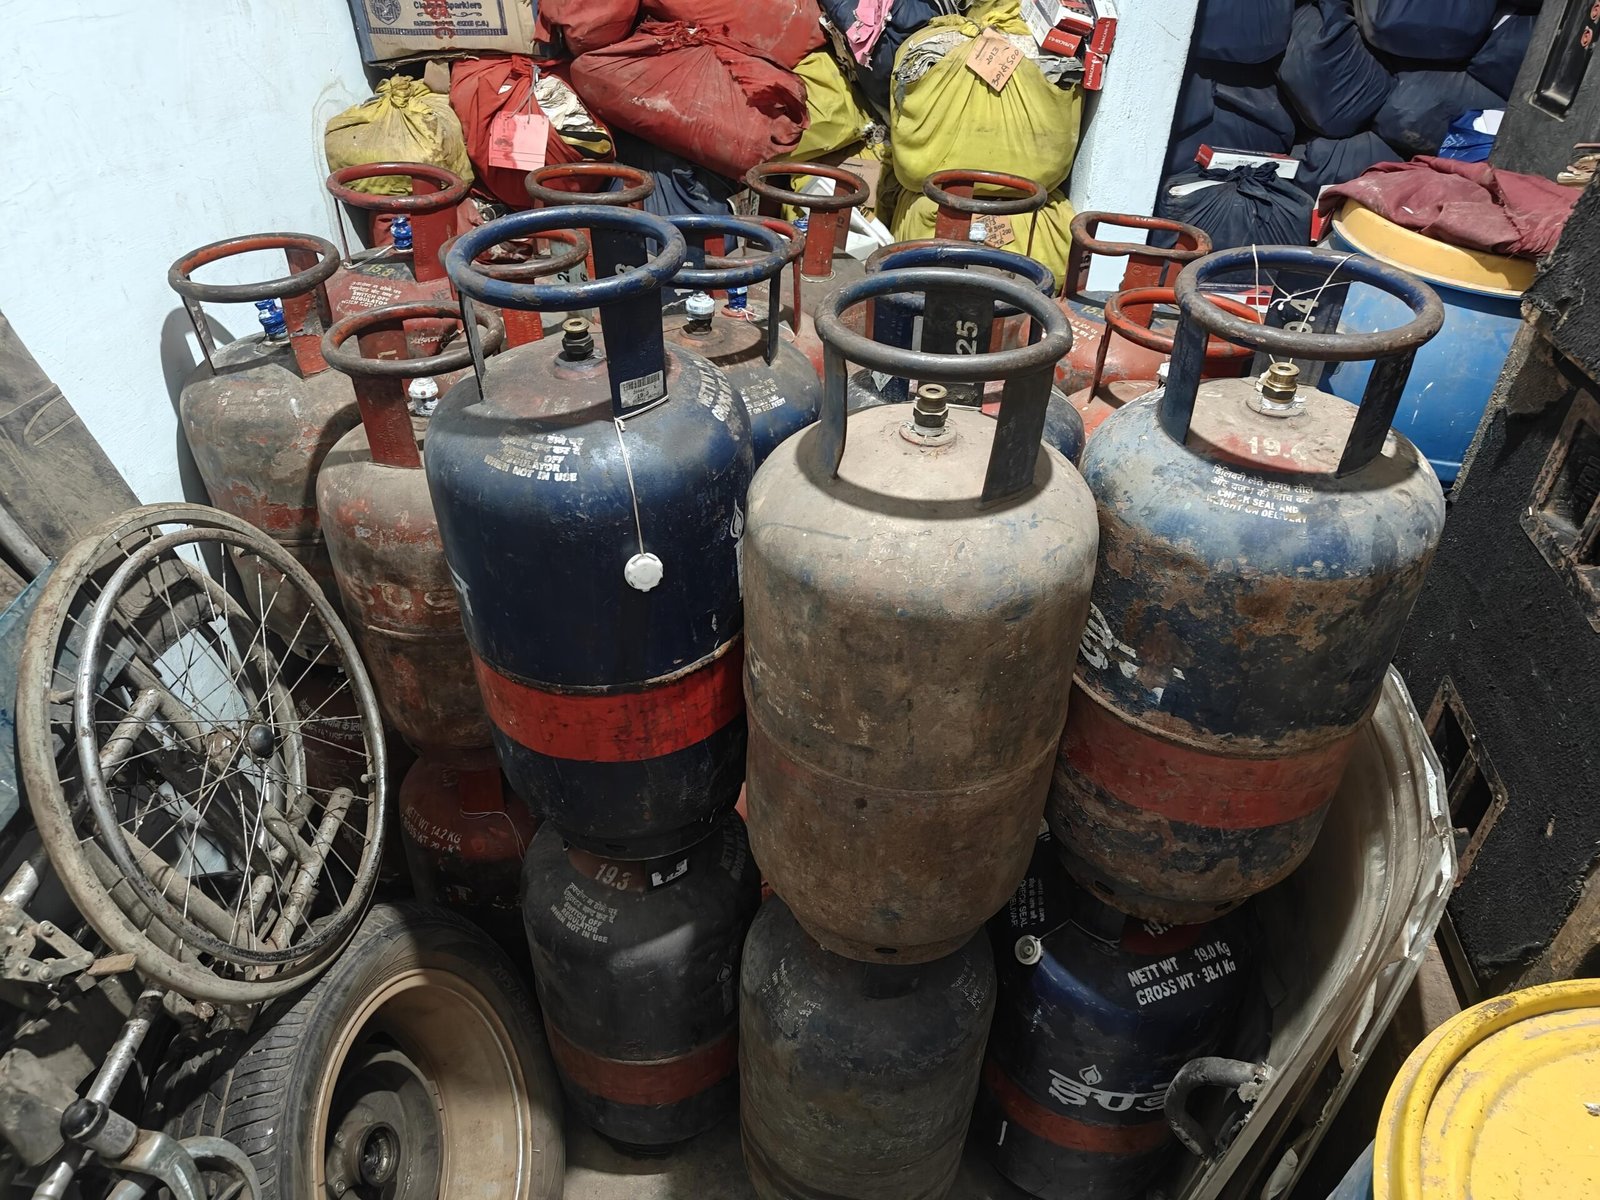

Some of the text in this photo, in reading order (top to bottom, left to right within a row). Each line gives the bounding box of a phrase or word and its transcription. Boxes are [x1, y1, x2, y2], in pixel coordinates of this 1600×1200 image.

[446, 1, 482, 11] Sparklers
[986, 46, 999, 65] 2013
[512, 466, 534, 478] NOT
[536, 471, 550, 480] IN
[554, 472, 577, 482] USE
[1217, 490, 1299, 514] CHECK SEAL AND
[430, 825, 447, 840] 14.2
[594, 863, 632, 891] 19.3
[550, 904, 609, 944] WHEN NOT IN USE
[560, 906, 599, 935] REGULATOR
[563, 901, 603, 928] SWITCH OFF
[1127, 940, 1232, 988] NETT WT 19.0 Kg
[1135, 979, 1178, 1006] GROSS
[1175, 972, 1196, 991] WT
[1201, 961, 1224, 983] 38.1
